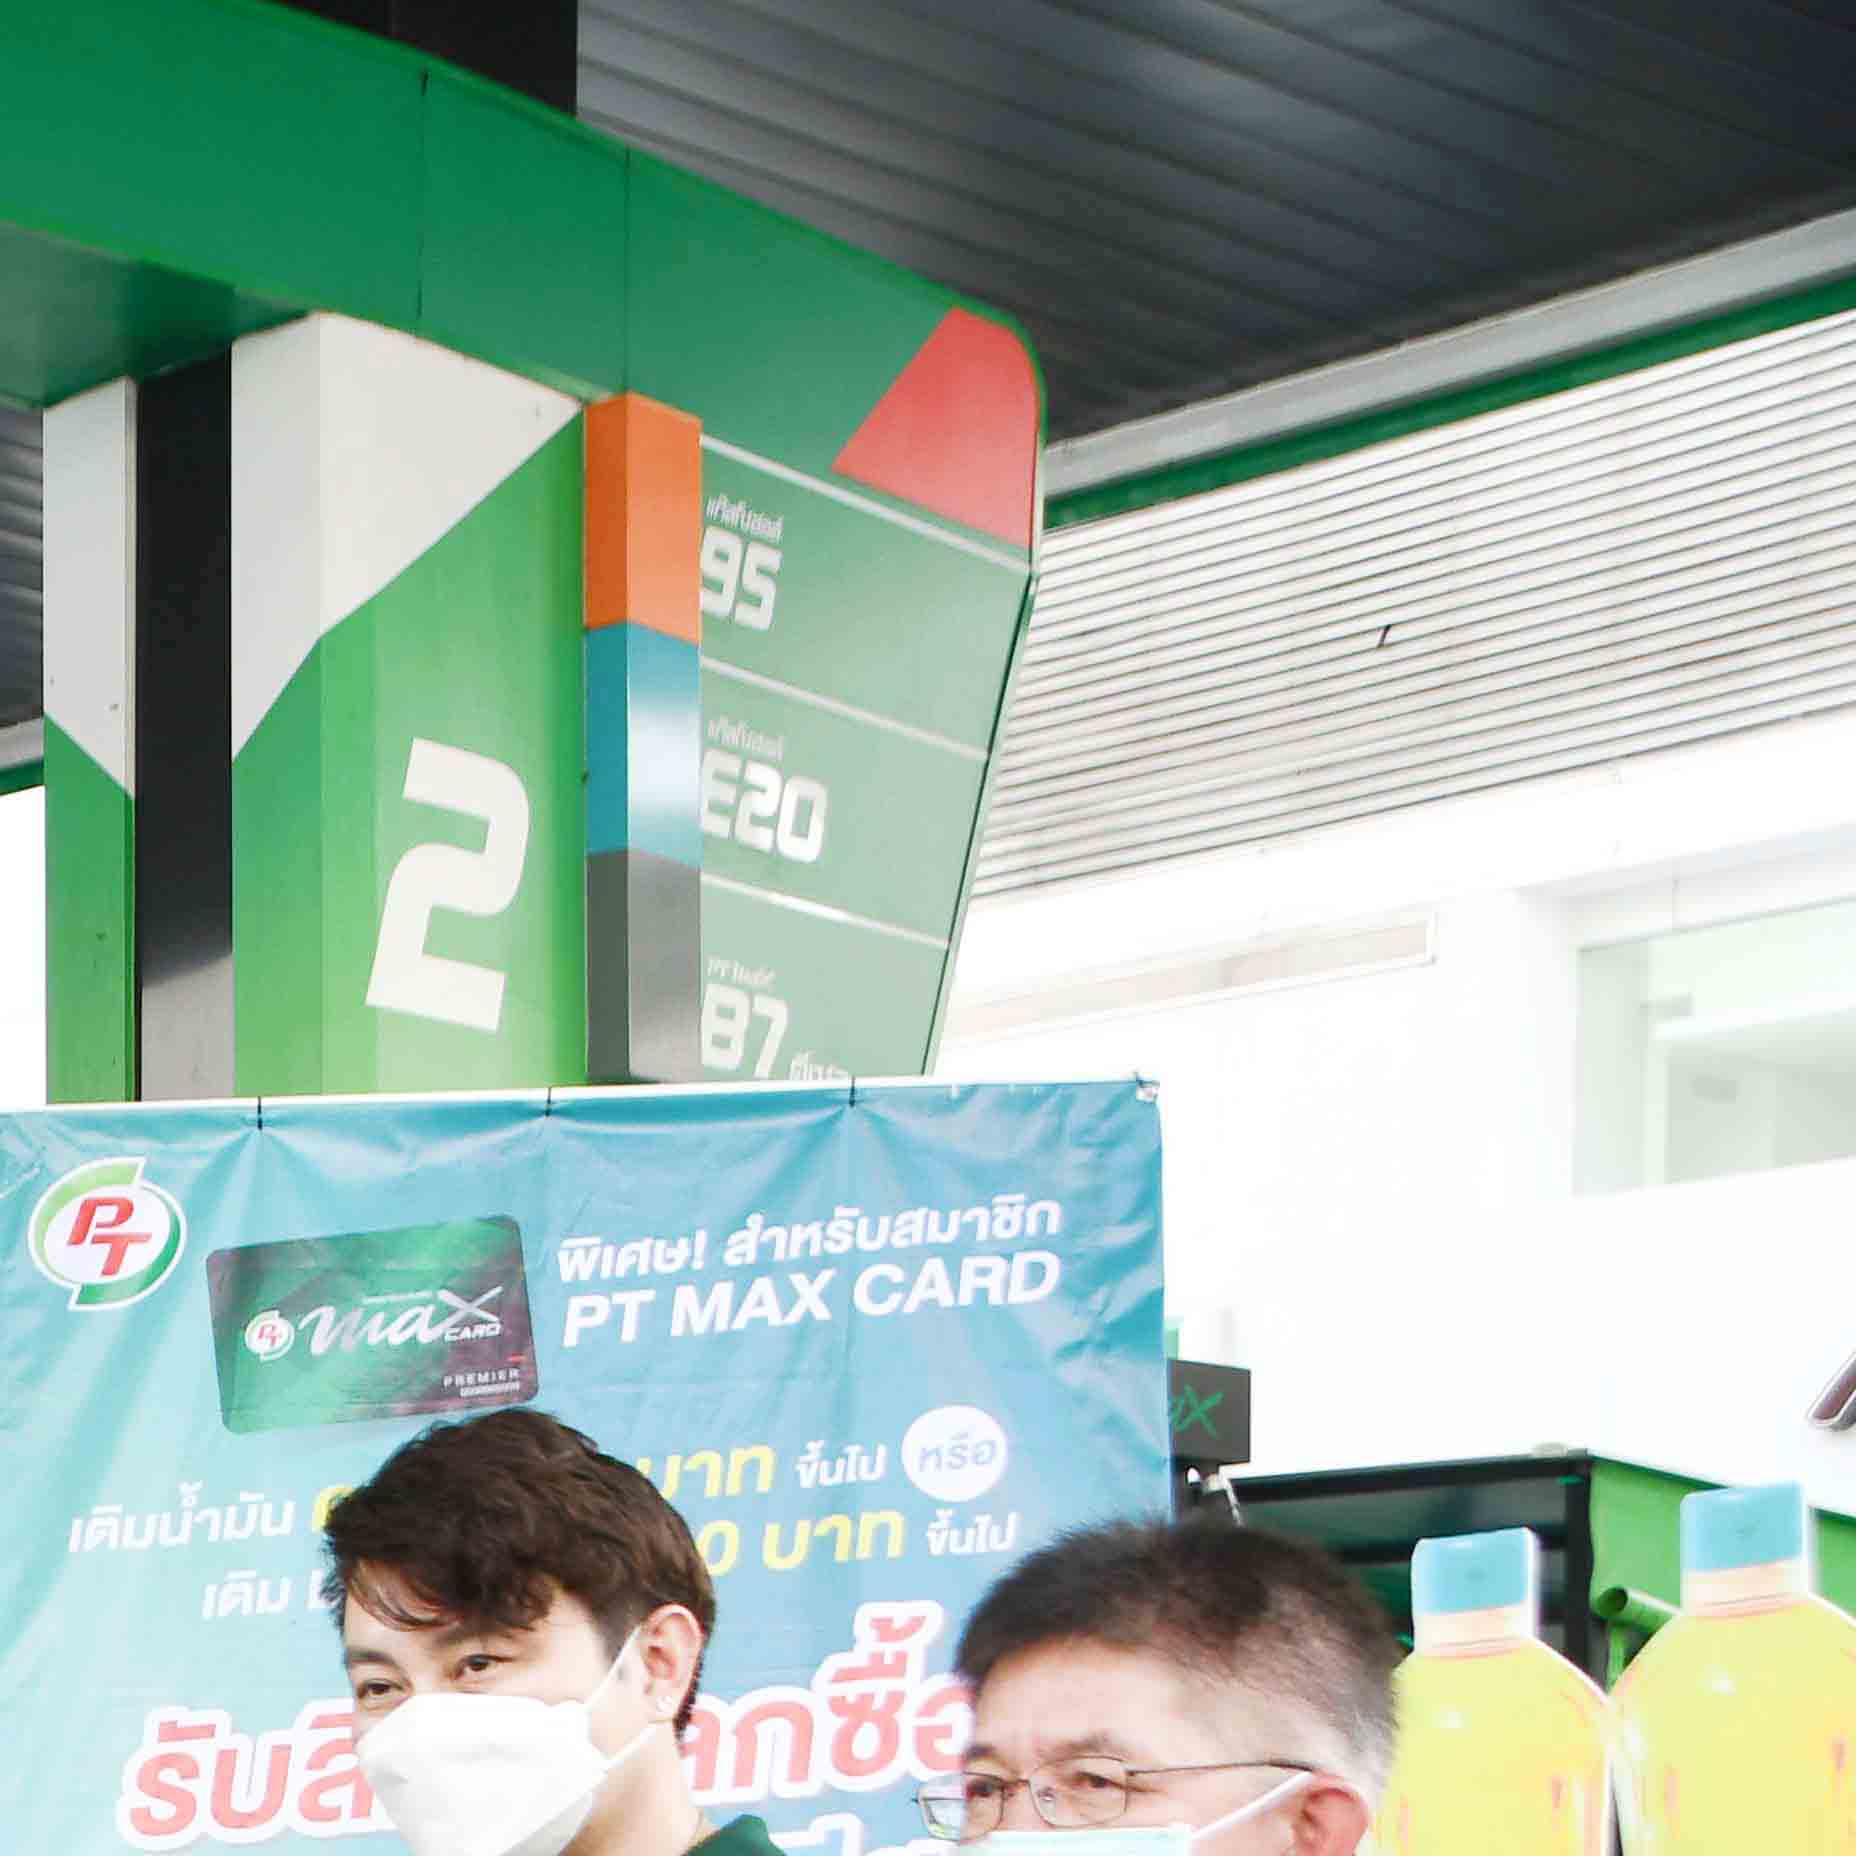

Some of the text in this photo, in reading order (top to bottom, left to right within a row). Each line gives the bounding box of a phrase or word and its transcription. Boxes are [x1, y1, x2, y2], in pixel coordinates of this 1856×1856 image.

[699, 525, 783, 632] 95
[700, 747, 828, 864] E20
[365, 737, 530, 1033] 2
[700, 984, 788, 1079] B7
[66, 1195, 153, 1278] PT
[557, 1193, 1063, 1282] พิเศษ! สำหรับสมาชิก
[444, 1323, 503, 1342] CARD
[561, 1248, 1062, 1348] PT MAX CARD
[442, 1367, 521, 1388] PREMIER
[796, 1438, 887, 1490] ขึ้นไป
[917, 1430, 997, 1474] หรือ
[68, 1478, 294, 1553] เติมน้ำมัน
[761, 1510, 905, 1566] บาท
[926, 1509, 1021, 1556] ขึ้นไป
[201, 1567, 289, 1620] เติม
